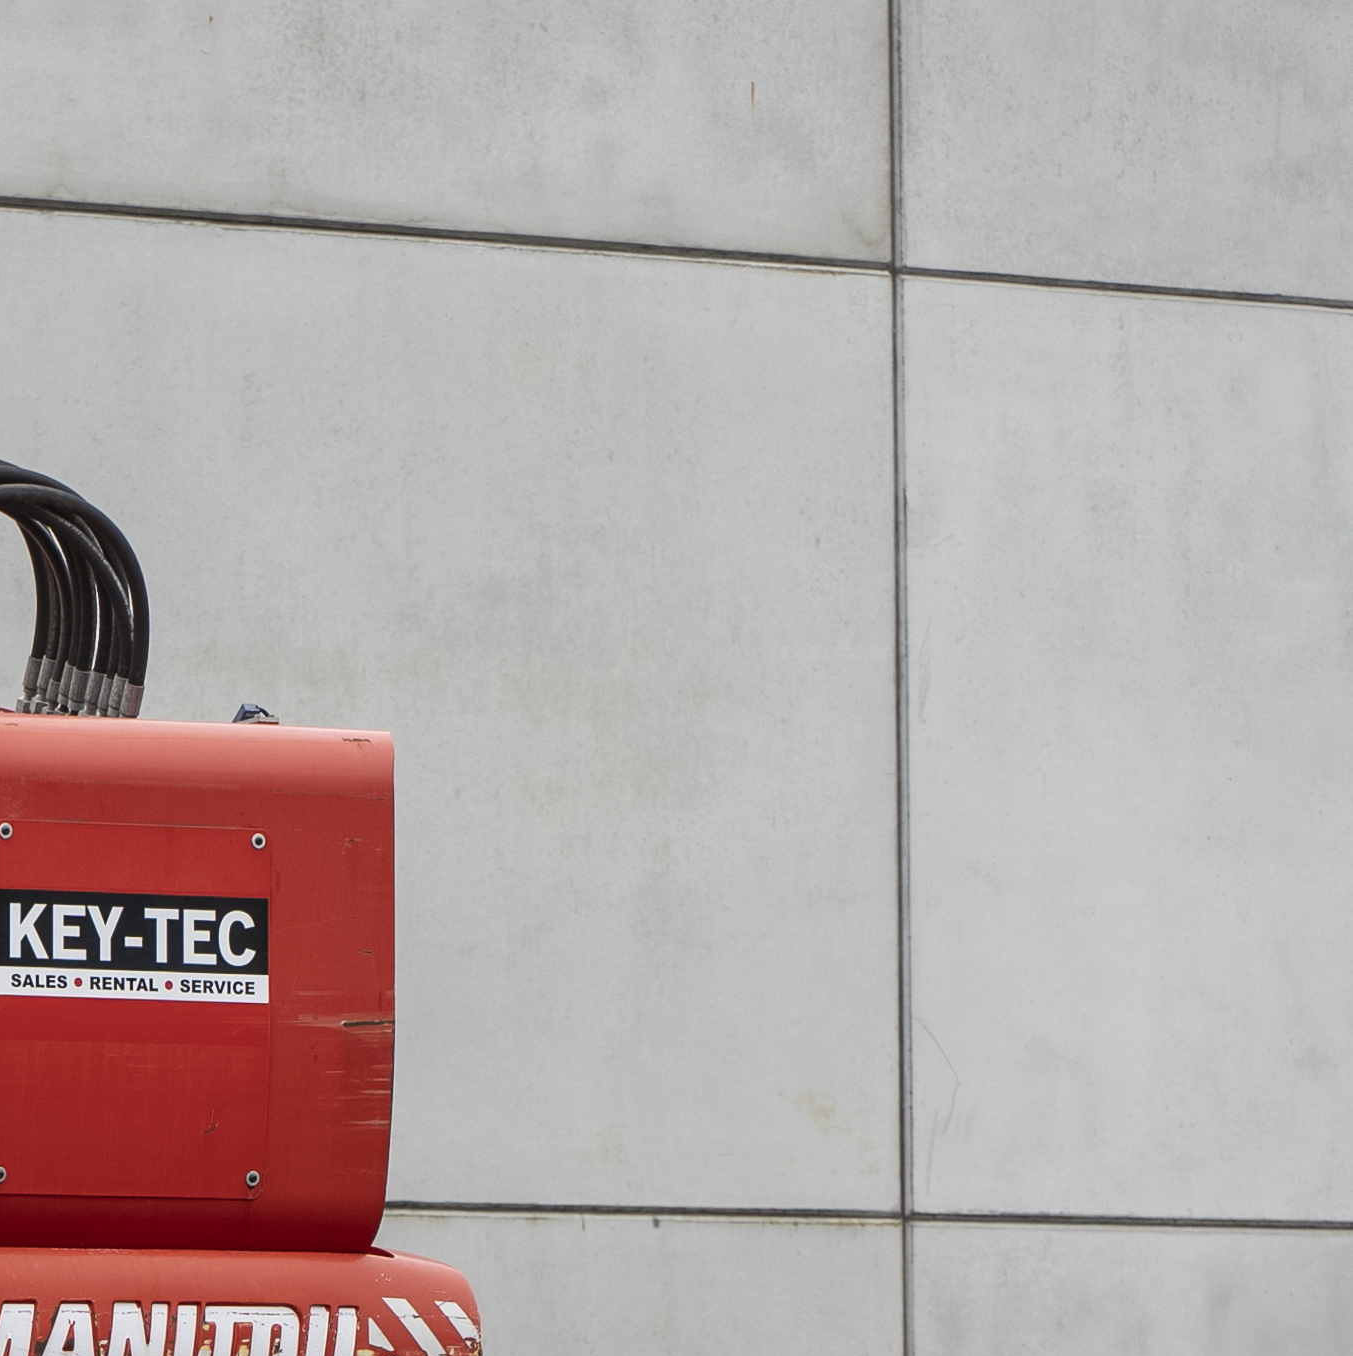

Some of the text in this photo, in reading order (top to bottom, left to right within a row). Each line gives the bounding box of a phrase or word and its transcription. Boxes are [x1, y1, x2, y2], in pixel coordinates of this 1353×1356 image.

[8, 902, 257, 967] KEY-TEC
[10, 973, 256, 996] SALES RENTAL SERVICE
